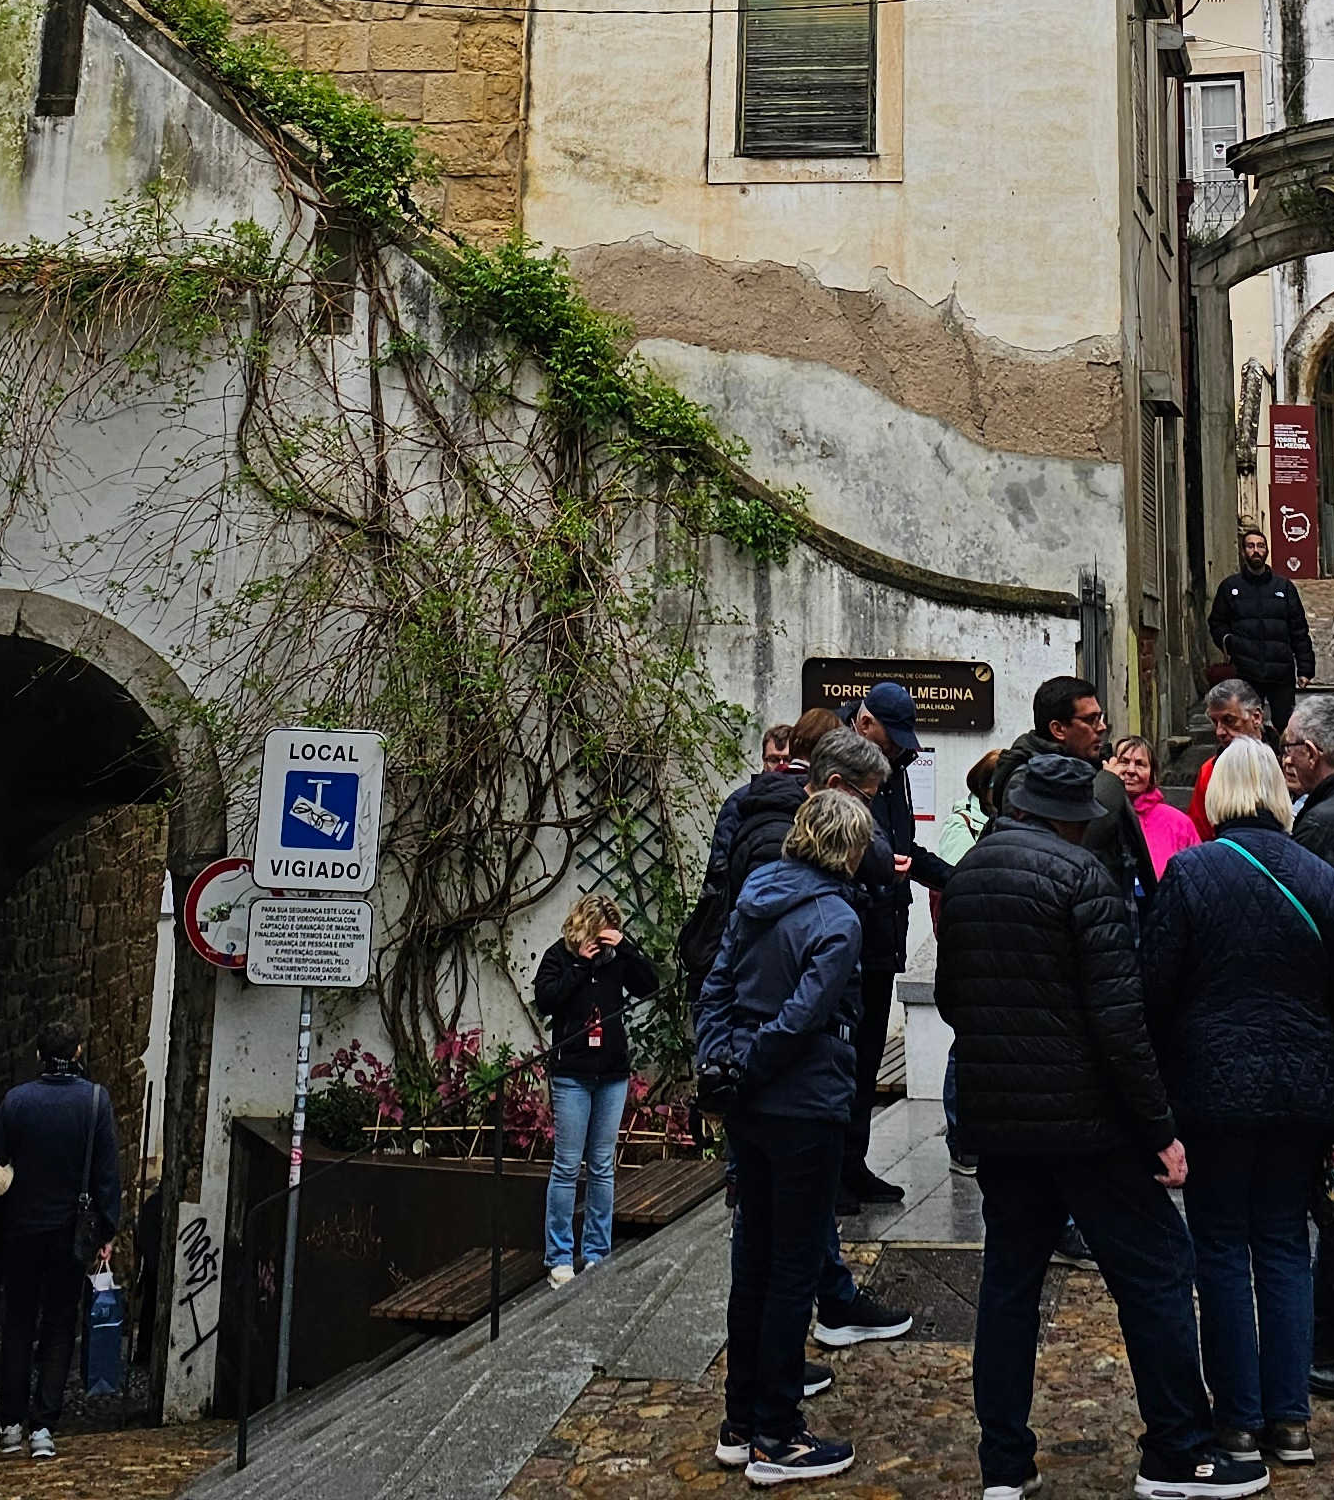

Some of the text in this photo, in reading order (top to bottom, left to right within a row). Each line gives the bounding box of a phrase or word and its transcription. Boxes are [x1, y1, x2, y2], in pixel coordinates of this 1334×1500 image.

[822, 684, 974, 700] TORRE LMEDINA
[289, 742, 359, 762] LOCAL
[270, 858, 361, 880] VIGIADO
